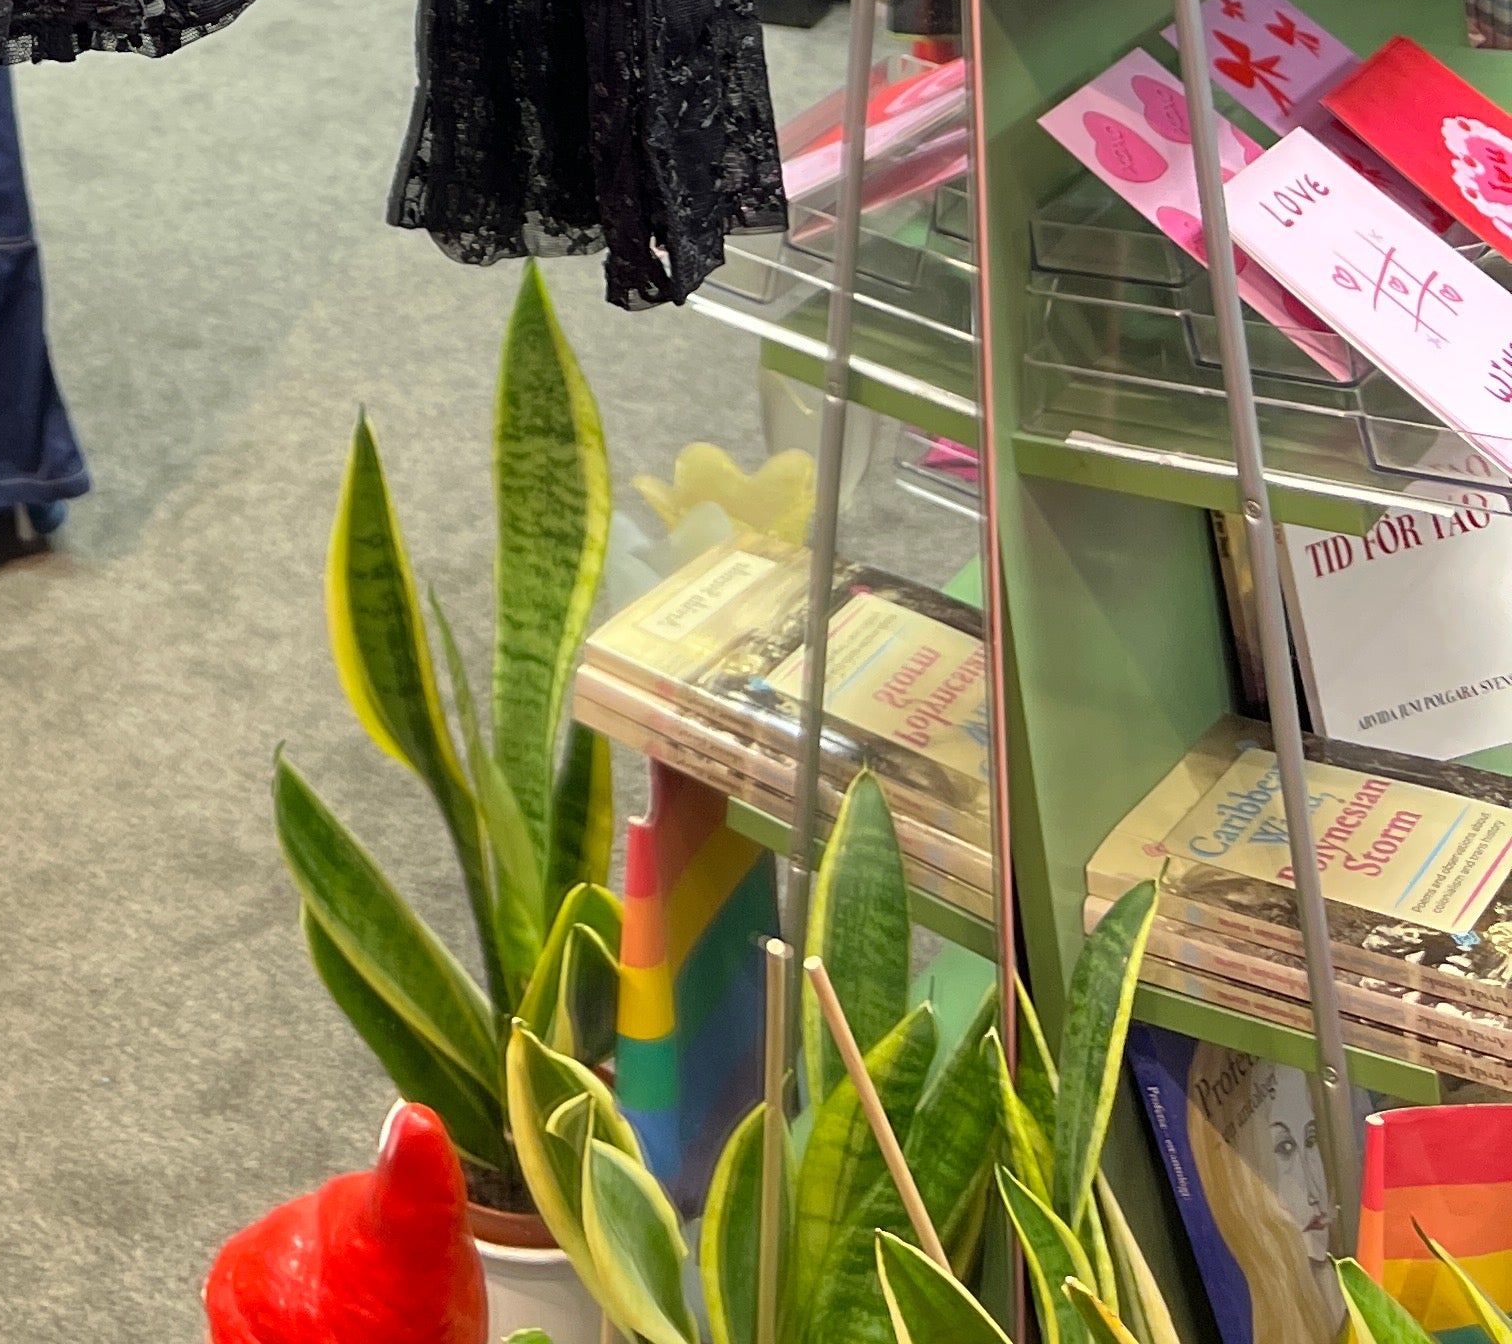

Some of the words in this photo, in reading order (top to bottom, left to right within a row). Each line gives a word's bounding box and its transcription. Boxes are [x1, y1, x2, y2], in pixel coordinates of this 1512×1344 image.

[1258, 174, 1330, 227] LOVE
[1305, 534, 1353, 577] TID
[1342, 810, 1423, 877] Storm
[1412, 889, 1436, 913] Poems
[1432, 874, 1446, 889] and
[1471, 812, 1490, 832] about
[1461, 860, 1475, 874] and
[1470, 843, 1488, 861] trans
[1481, 820, 1506, 843] history
